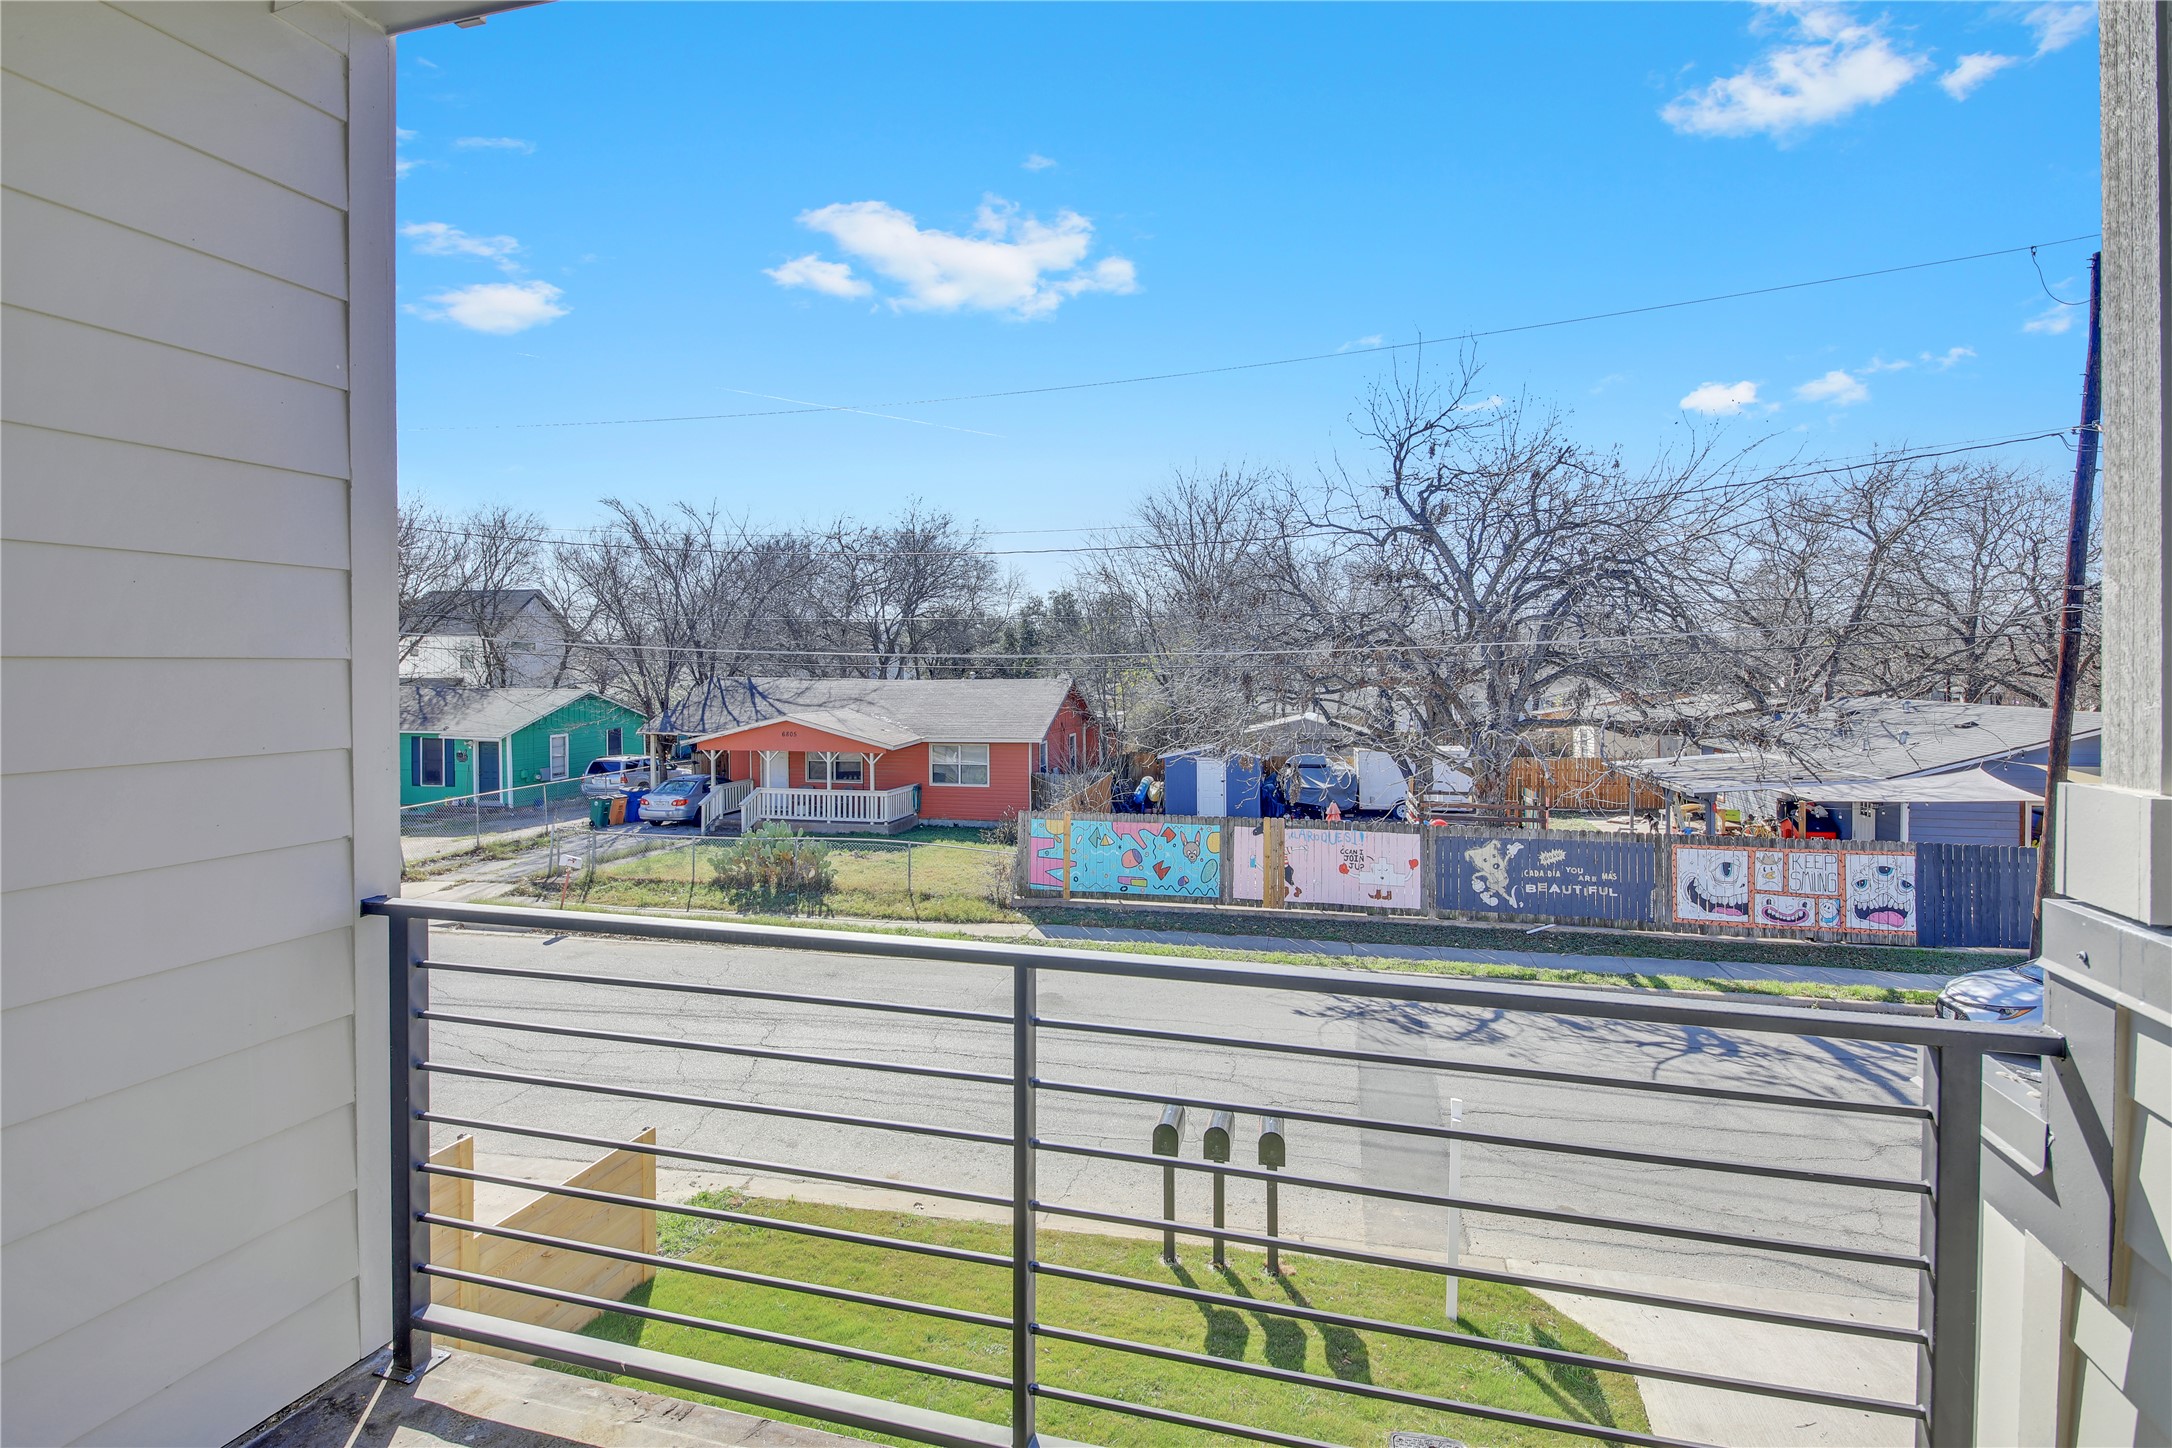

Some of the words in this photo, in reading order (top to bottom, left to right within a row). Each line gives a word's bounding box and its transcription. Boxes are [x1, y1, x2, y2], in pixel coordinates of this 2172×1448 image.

[1321, 832, 1343, 845] QUE
[1792, 854, 1836, 870] KEEP
[1525, 882, 1618, 896] BEAUTIFUL
[1790, 871, 1836, 892] SMILING
